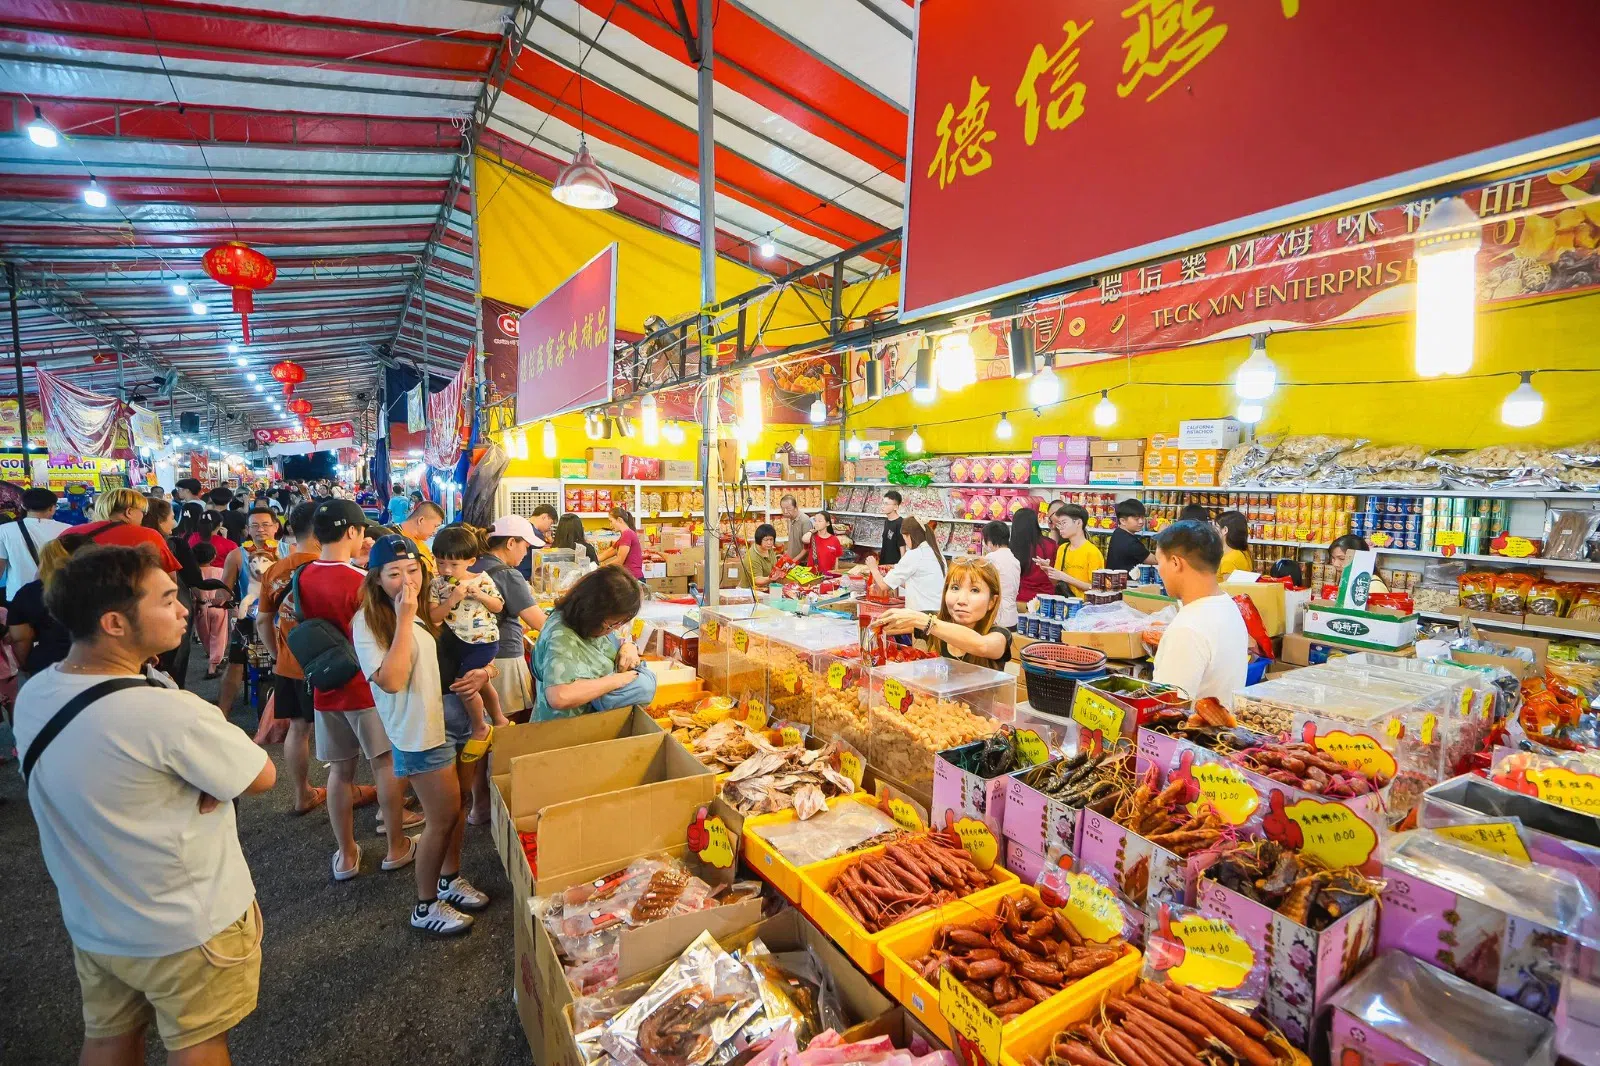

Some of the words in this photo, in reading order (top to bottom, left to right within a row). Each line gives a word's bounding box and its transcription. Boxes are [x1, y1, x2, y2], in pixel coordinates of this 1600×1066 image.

[1151, 299, 1202, 331] TECK
[1207, 289, 1247, 318] XIN
[1255, 258, 1417, 309] ENTERPRISE
